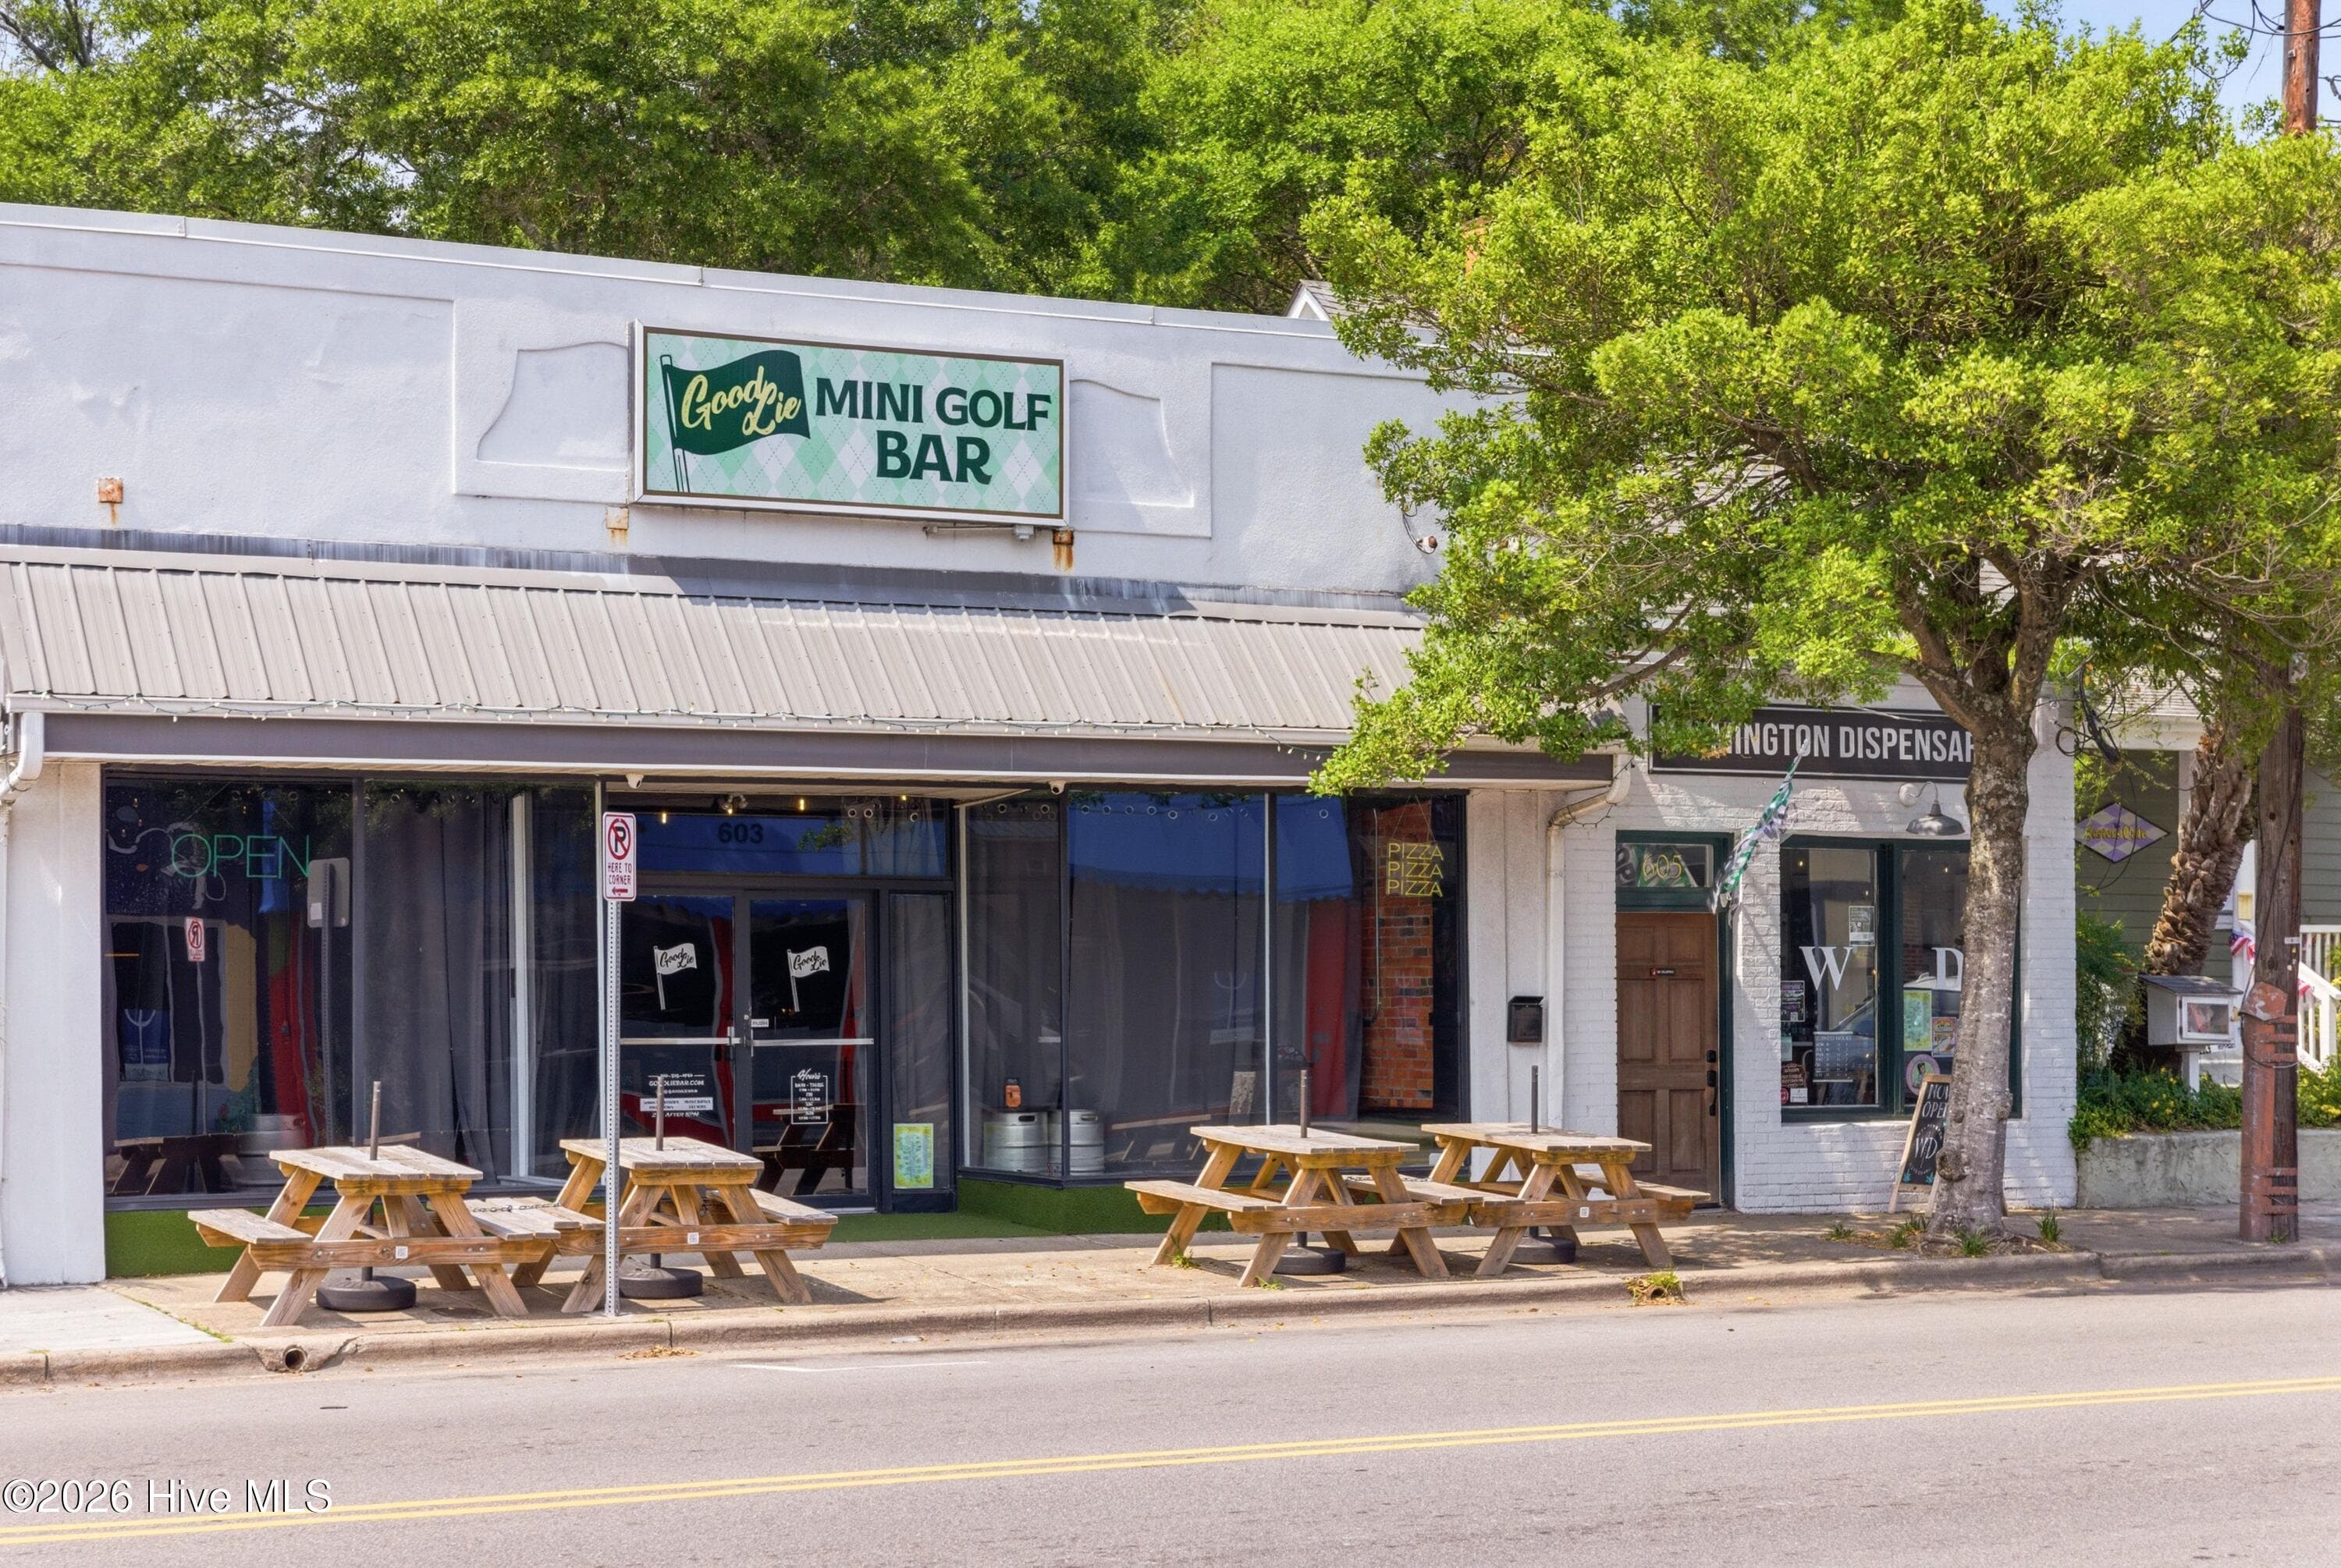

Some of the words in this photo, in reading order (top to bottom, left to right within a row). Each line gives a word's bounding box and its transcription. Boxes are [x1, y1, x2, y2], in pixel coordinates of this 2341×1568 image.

[680, 366, 766, 431] Good
[815, 377, 924, 424] MINI
[936, 387, 1052, 431] GOLF
[742, 391, 802, 435] Lie
[876, 430, 993, 484] BAR
[1710, 722, 1830, 757] INGTON
[717, 822, 763, 844] 603
[171, 834, 310, 879] OPEN
[1388, 843, 1444, 860] PIZZA
[608, 862, 623, 873] HERE
[624, 862, 632, 873] TO
[1388, 861, 1444, 879] PIZZA
[1643, 853, 1682, 881] 605
[608, 874, 631, 885] CORNER
[1387, 879, 1443, 897] PIZZA
[659, 948, 684, 969] Good
[794, 950, 818, 970] Good
[1799, 945, 1853, 992] W
[1931, 947, 1964, 990] D
[797, 1067, 821, 1081] Hours
